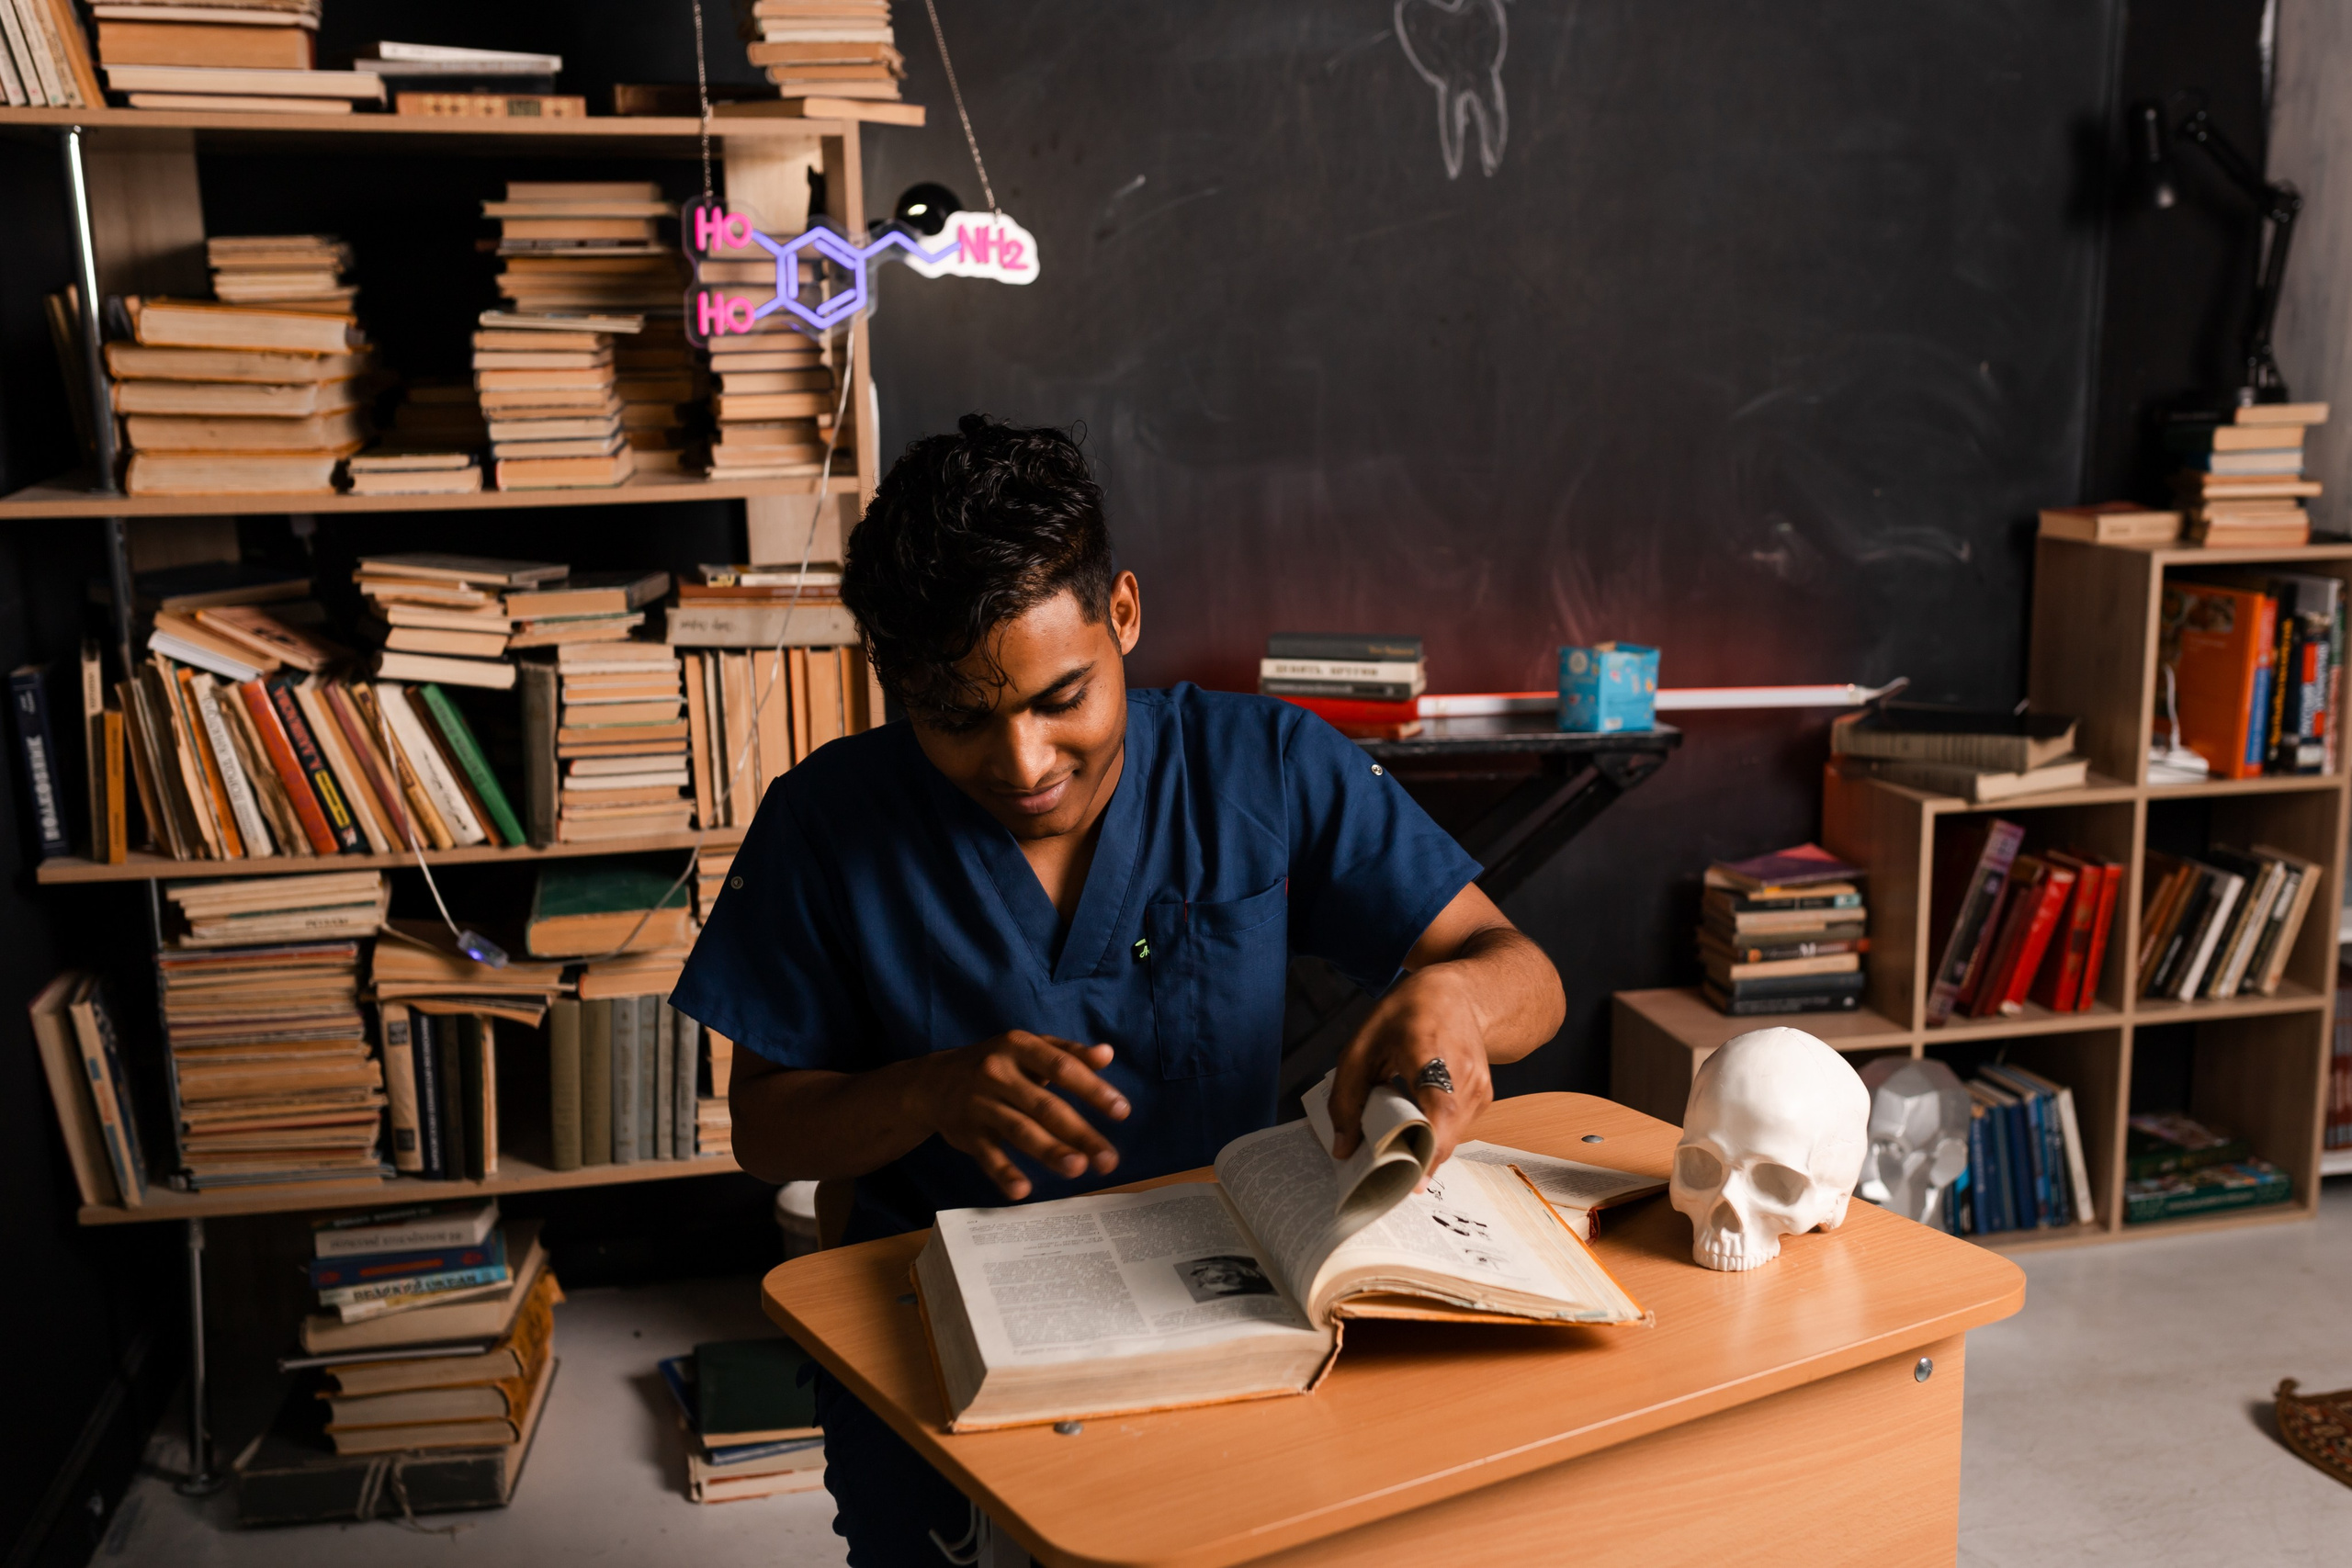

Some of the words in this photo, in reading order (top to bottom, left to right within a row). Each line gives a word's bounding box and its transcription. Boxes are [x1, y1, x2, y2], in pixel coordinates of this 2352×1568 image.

[694, 205, 754, 252] HO
[957, 224, 1028, 271] NH2
[697, 290, 756, 337] HO
